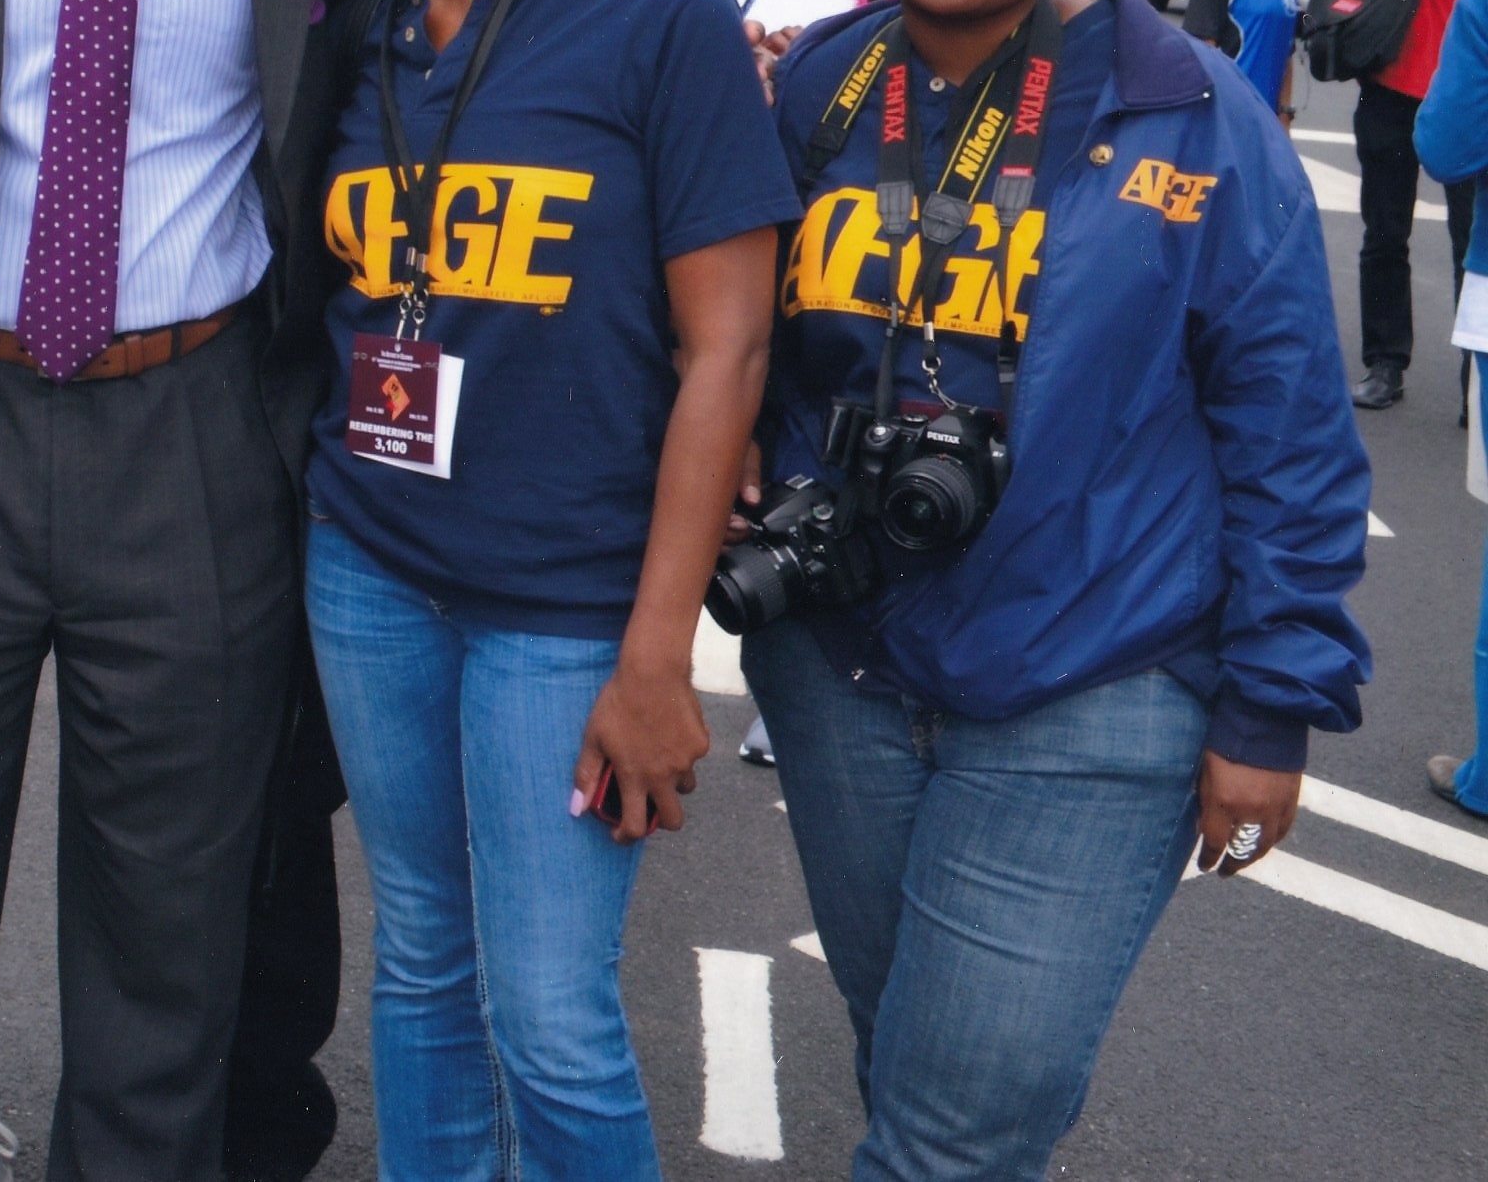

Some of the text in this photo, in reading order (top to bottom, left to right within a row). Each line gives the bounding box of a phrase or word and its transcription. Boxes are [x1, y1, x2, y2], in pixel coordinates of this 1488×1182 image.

[838, 42, 887, 109] Nikon
[883, 64, 908, 144] PENTAX
[1014, 57, 1054, 136] PENTAX
[954, 106, 1005, 181] Nikon
[1117, 158, 1218, 223] AFGE
[349, 420, 434, 443] REMEMBERING THE
[374, 438, 408, 455] 3,100
[927, 431, 960, 445] PENTAX
